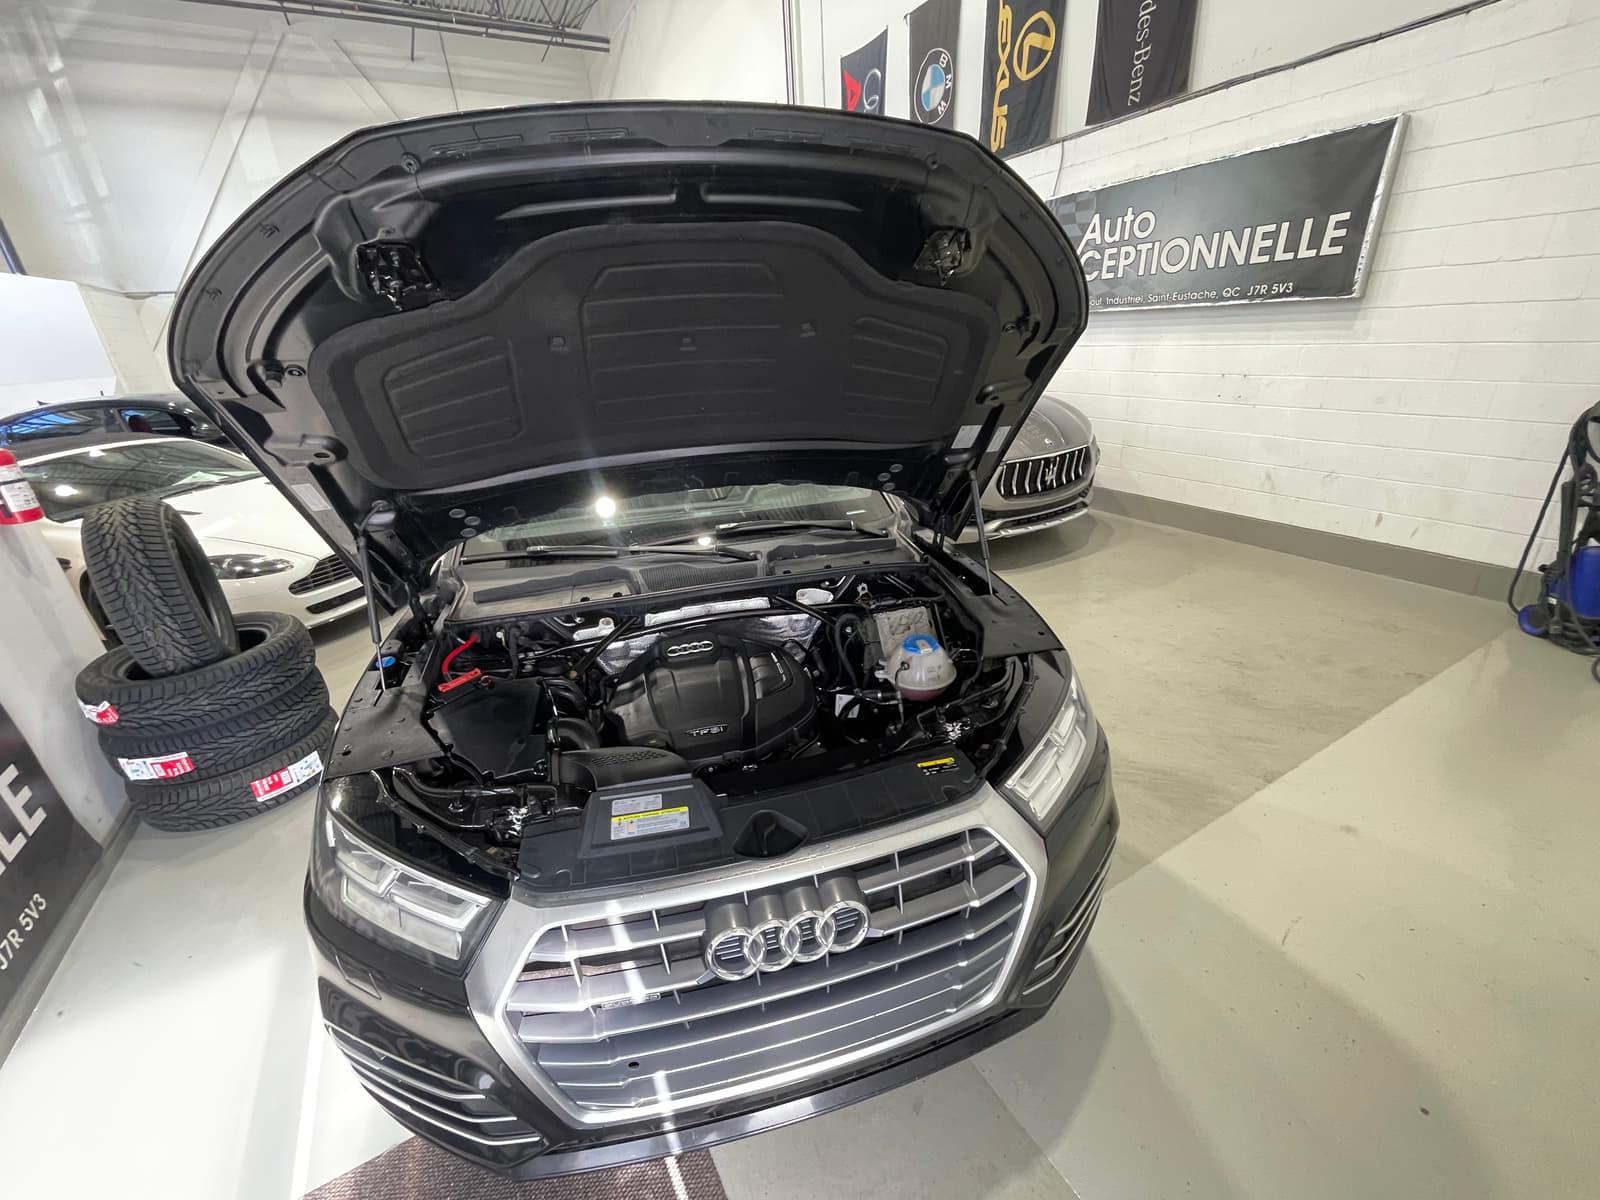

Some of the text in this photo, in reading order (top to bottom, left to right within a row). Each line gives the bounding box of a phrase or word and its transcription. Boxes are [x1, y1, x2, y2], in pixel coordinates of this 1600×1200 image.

[937, 53, 952, 115] BMW
[991, 0, 1012, 153] EXUS
[1077, 207, 1156, 255] Auto
[1222, 286, 1241, 298] QC
[1247, 283, 1269, 297] J7R
[1271, 282, 1294, 294] 5V3
[0, 763, 47, 877] LE
[18, 893, 47, 932] 5V3
